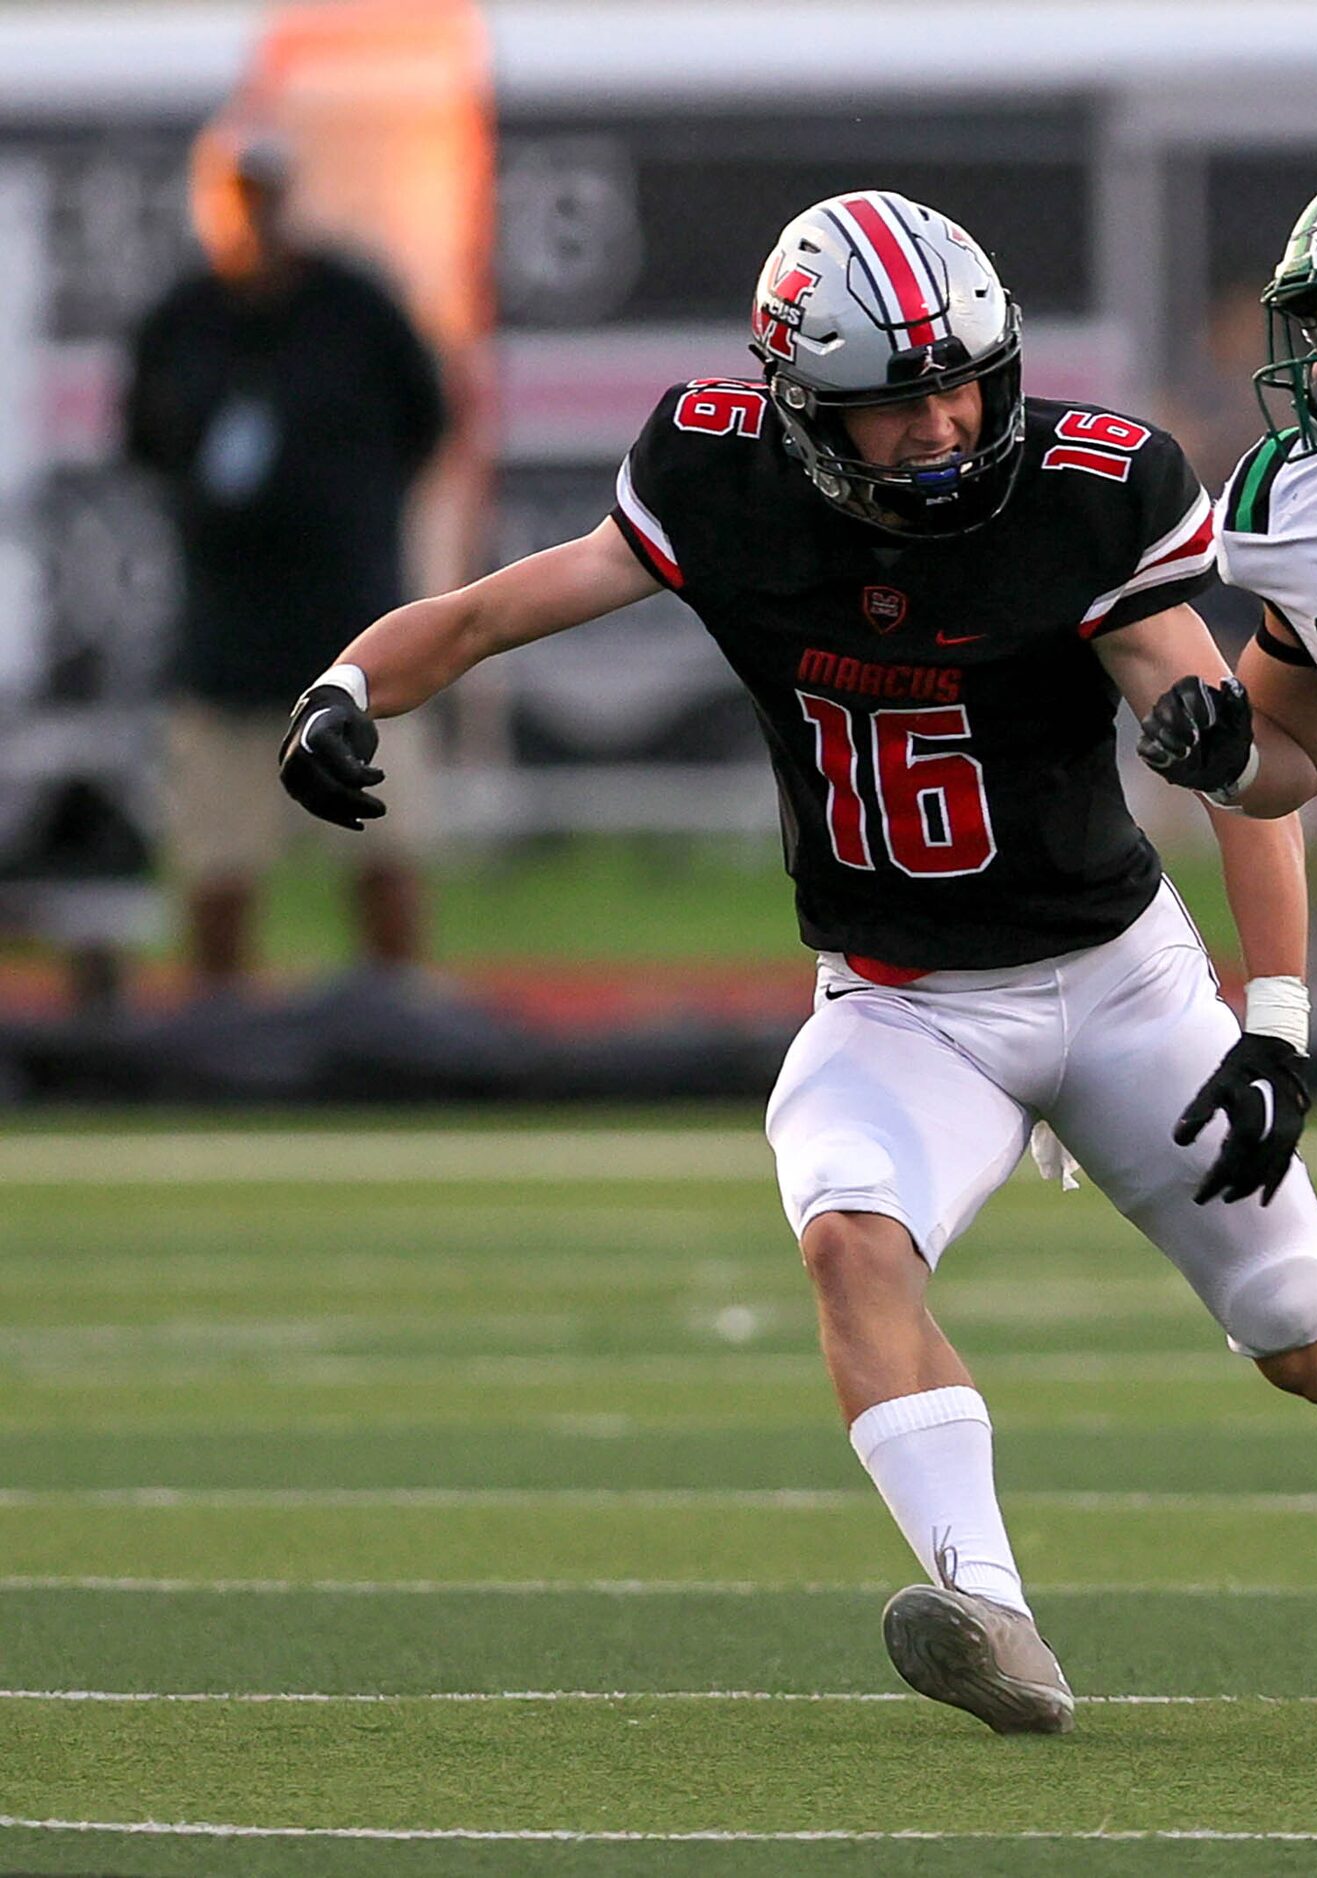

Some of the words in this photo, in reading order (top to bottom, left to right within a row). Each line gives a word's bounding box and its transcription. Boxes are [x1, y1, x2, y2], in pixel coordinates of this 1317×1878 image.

[1041, 409, 1152, 484] 16
[796, 647, 964, 704] MARCUS
[794, 688, 999, 879] 16
